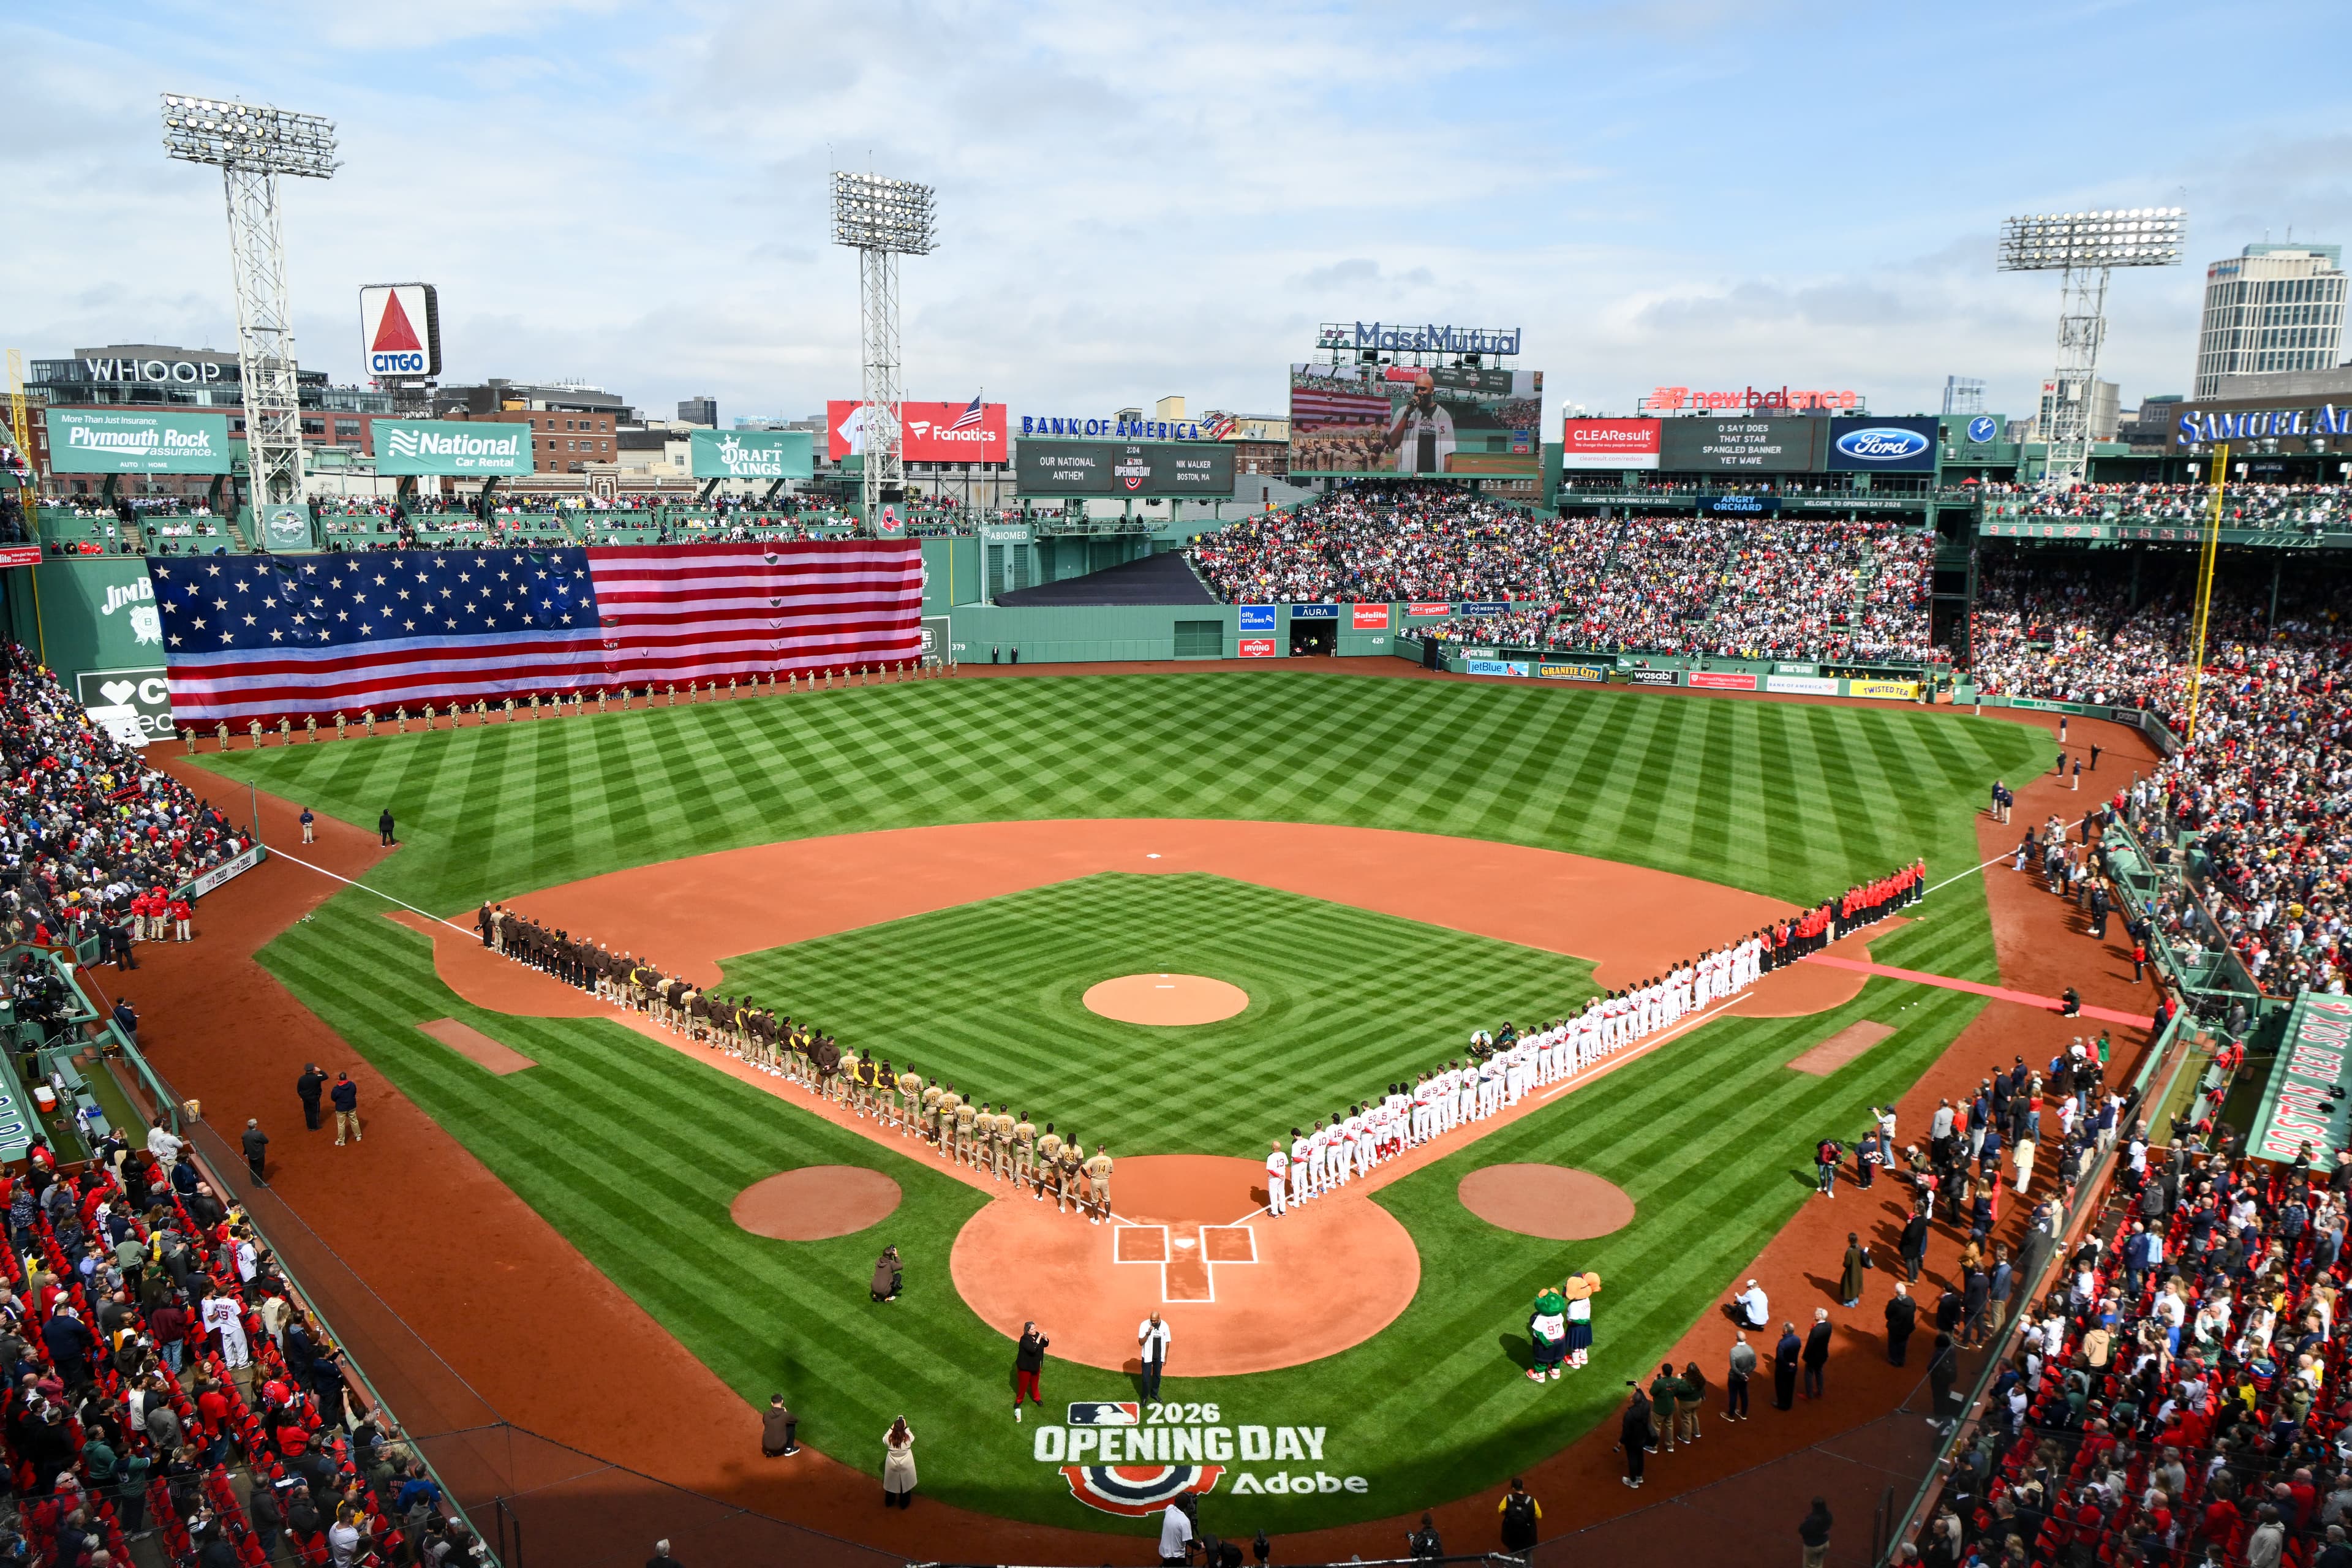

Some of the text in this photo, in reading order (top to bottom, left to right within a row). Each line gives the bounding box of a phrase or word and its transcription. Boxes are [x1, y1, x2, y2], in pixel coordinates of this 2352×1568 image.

[1355, 321, 1521, 355] MassMutual
[373, 353, 423, 372] CITGO
[86, 358, 220, 384] WHOOP
[62, 415, 83, 423] More
[85, 415, 103, 424] Than
[121, 417, 158, 425] Insurance.
[1023, 417, 1199, 439] BANK OF AMERICA
[2177, 410, 2308, 445] SAMUEL
[69, 427, 210, 447] Plymouth Rock
[933, 426, 996, 442] Fanatics
[1339, 434, 1343, 443] 3
[1359, 434, 1363, 442] 2
[1371, 431, 1380, 439] 23
[1574, 429, 1651, 441] CLEAResult
[1292, 438, 1299, 447] 41
[1854, 432, 1909, 454] Ford
[721, 448, 783, 464] DRAFT
[456, 458, 514, 467] Car Rental
[730, 461, 782, 475] KINGS
[1040, 458, 1096, 467] OUR NATIONAL
[1052, 471, 1084, 480] ANTHEM
[1115, 466, 1150, 477] OPENING DAY
[1713, 502, 1762, 511] ORCHARD
[2008, 526, 2018, 535] 4
[2027, 526, 2033, 535] 1
[2063, 527, 2081, 537] 27
[101, 584, 138, 616] JIM
[1471, 662, 1502, 672] jetBlue
[1540, 666, 1600, 679] GRANITE CITY
[1634, 671, 1672, 680] wasabi
[1896, 687, 1909, 696] TEA
[240, 855, 251, 867] TRULY
[216, 868, 227, 881] TRULY
[2298, 1012, 2352, 1049] SOX
[2288, 1045, 2344, 1084] RED
[1422, 1089, 1430, 1098] 89
[1368, 1115, 1376, 1124] 52
[2263, 1081, 2334, 1163] BOSTON
[1318, 1137, 1327, 1146] 10
[1300, 1145, 1307, 1155] 19
[1065, 1152, 1074, 1161] 23
[1276, 1158, 1284, 1167] 13
[1548, 1324, 1560, 1335] 97
[1147, 1403, 1220, 1424] 2026
[1034, 1425, 1326, 1462] OPENING DAY
[1231, 1471, 1368, 1494] Adobe
